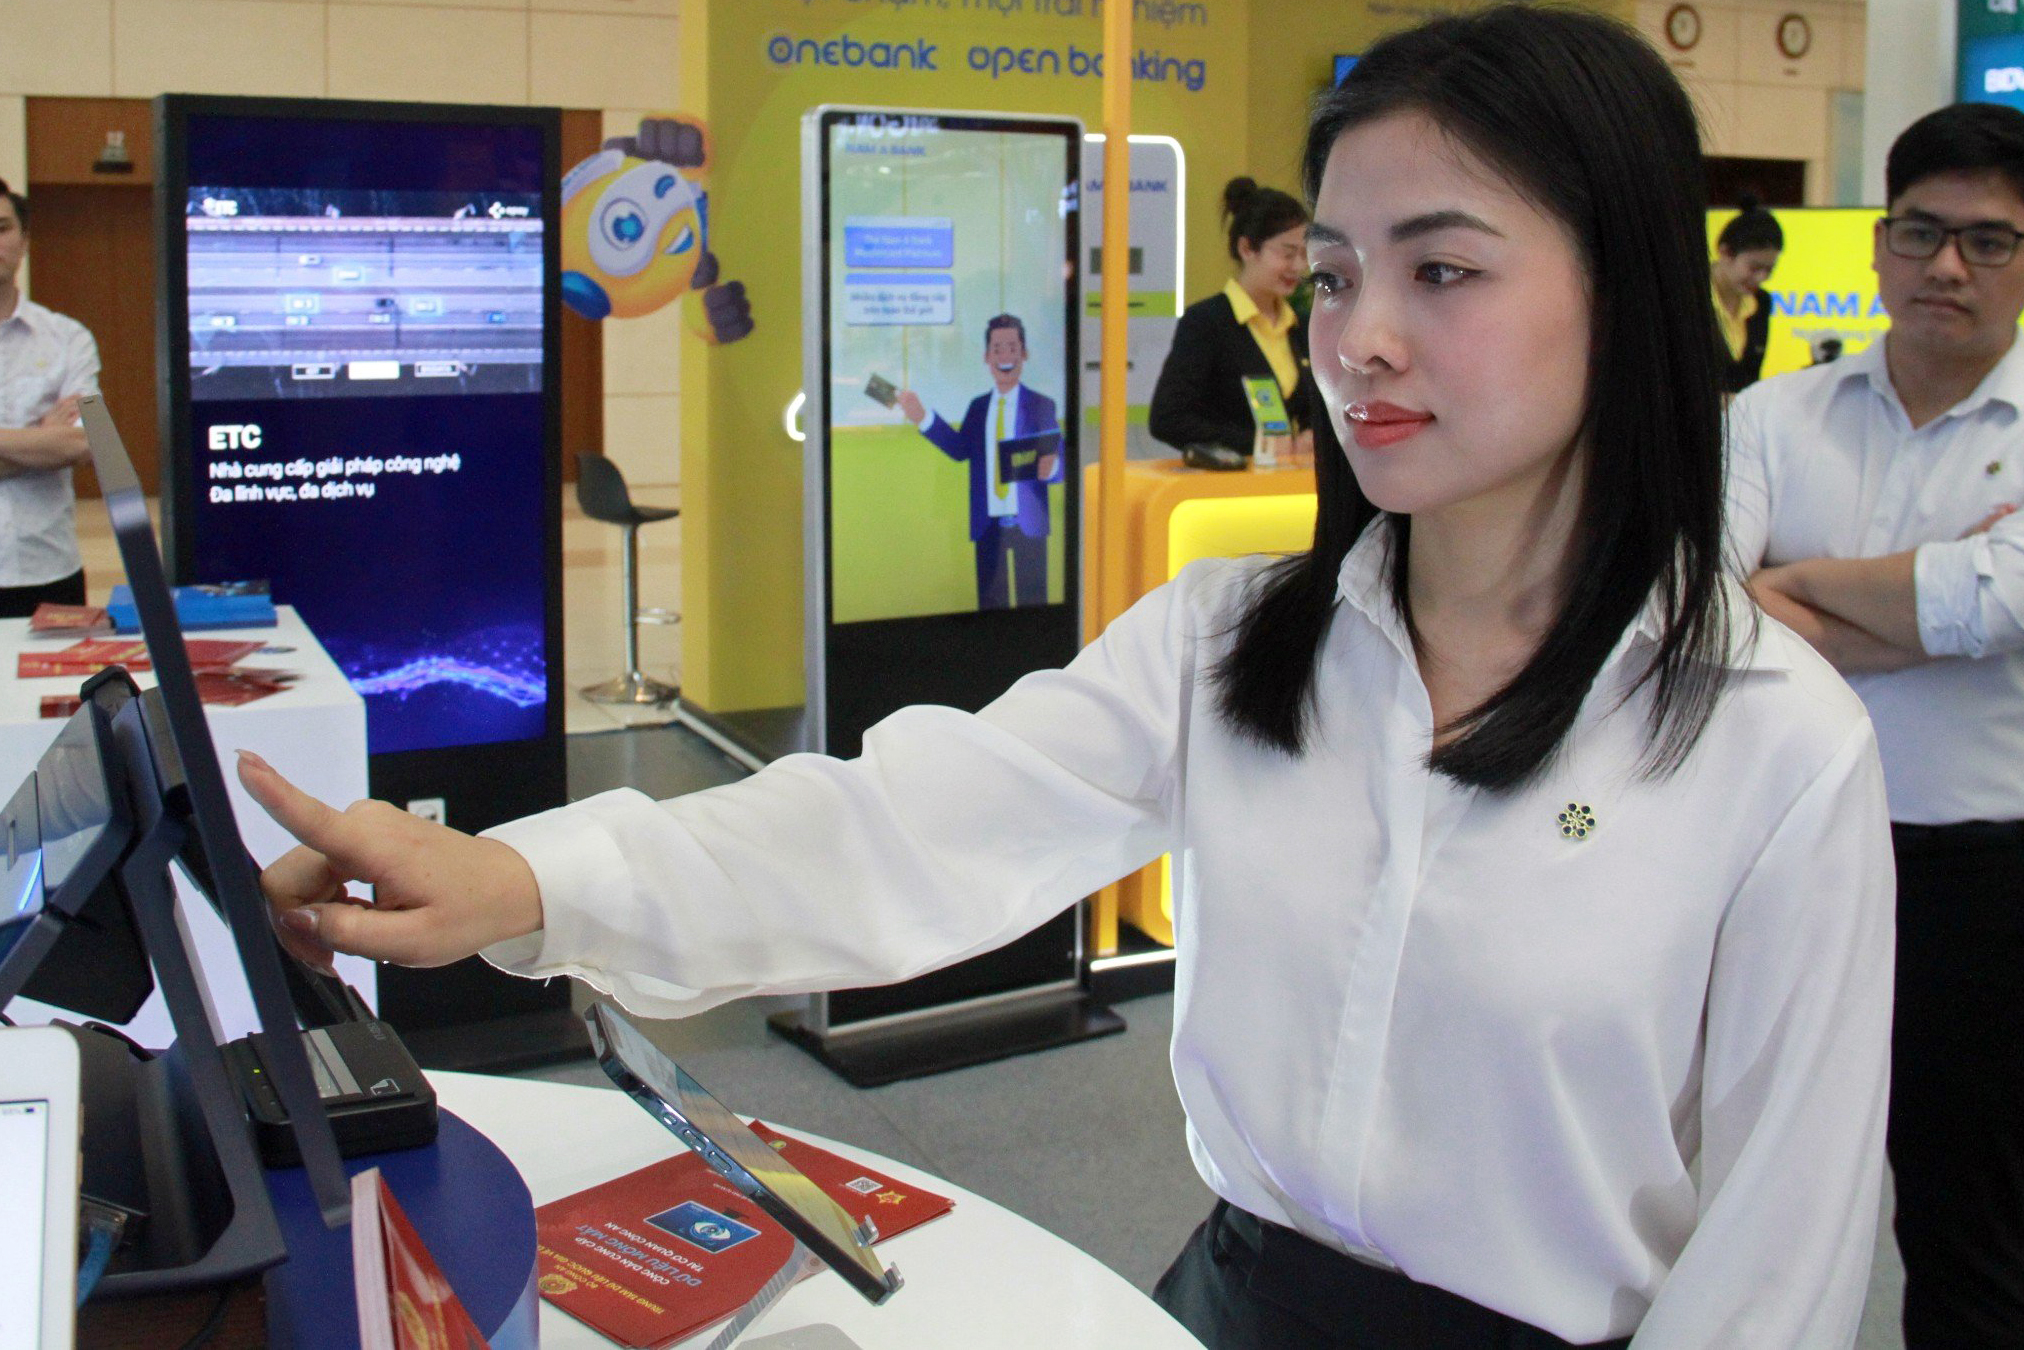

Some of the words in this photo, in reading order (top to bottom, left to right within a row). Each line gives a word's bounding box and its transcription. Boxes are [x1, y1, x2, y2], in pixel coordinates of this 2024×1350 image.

[967, 44, 1060, 79] open
[1068, 45, 1207, 92] bking
[1770, 291, 1860, 317] NAM
[209, 424, 262, 450] ETC
[209, 461, 242, 479] Nhà
[244, 461, 283, 480] cung
[284, 458, 314, 478] cấp
[315, 457, 344, 478] giải
[345, 456, 383, 476] pháp
[384, 455, 422, 475] công
[423, 453, 461, 474] nghệ
[298, 482, 320, 500] đa
[321, 481, 354, 500] dịch
[355, 482, 375, 498] vụ
[604, 1222, 622, 1231] AN
[575, 1237, 596, 1248] CẤP
[619, 1229, 647, 1244] CÔNG
[594, 1246, 622, 1260] CUNG
[645, 1241, 674, 1257] QUAN
[620, 1258, 643, 1271] DÂN
[645, 1258, 680, 1276] LIỆU
[641, 1269, 670, 1285] CÔNG
[673, 1273, 702, 1287] DỮ
